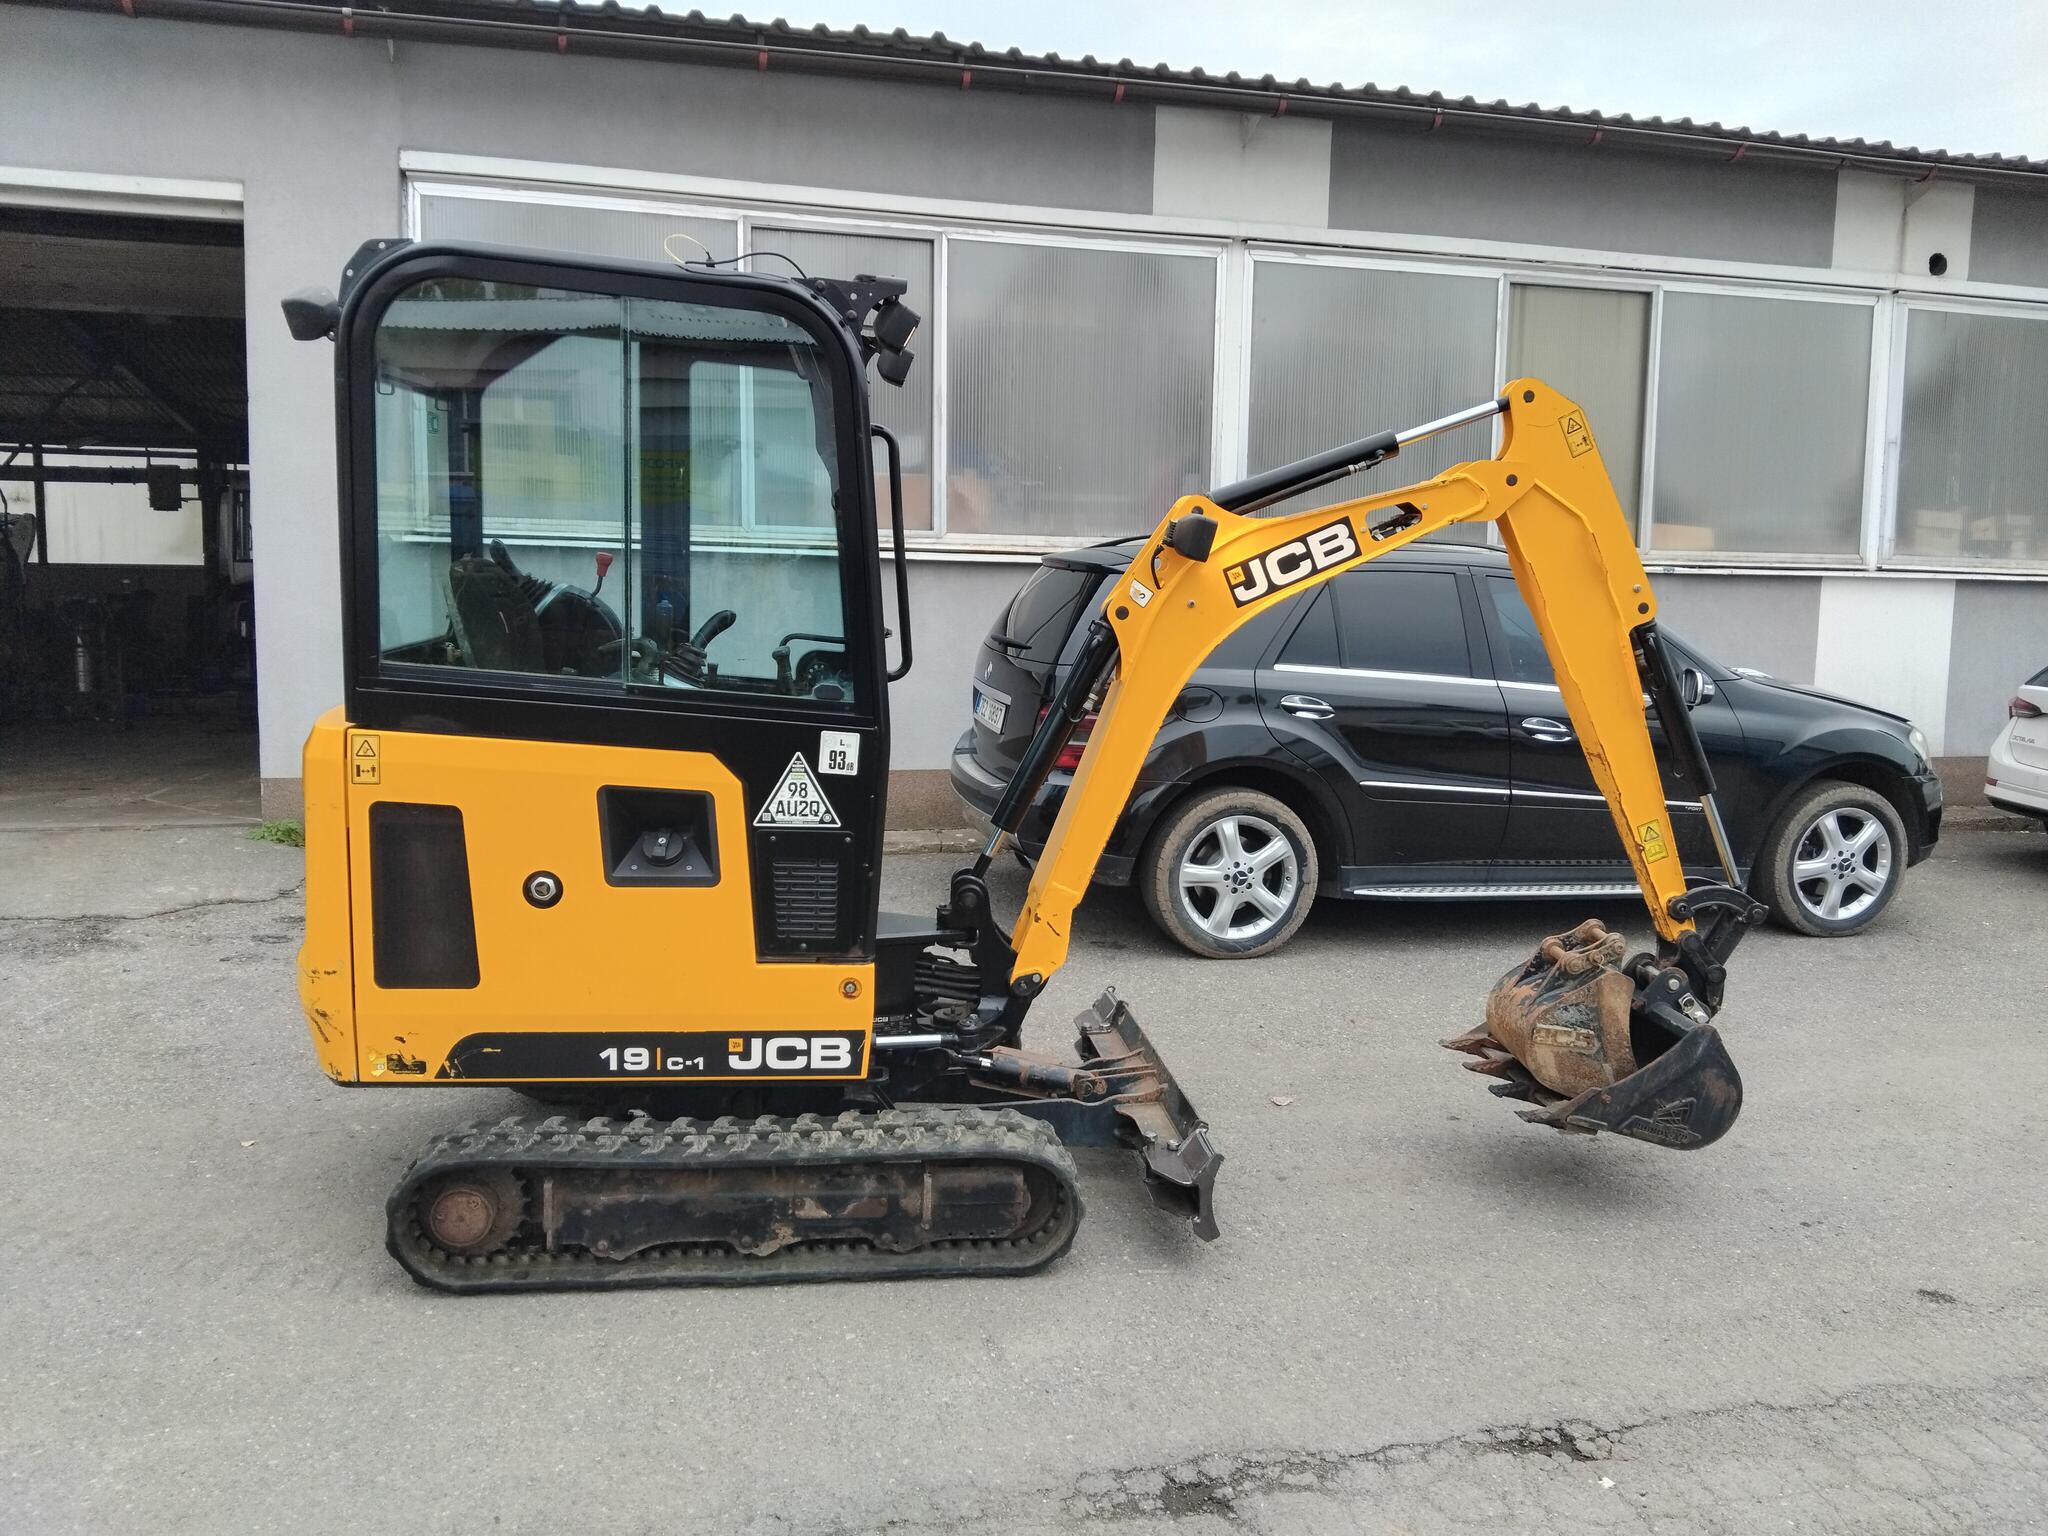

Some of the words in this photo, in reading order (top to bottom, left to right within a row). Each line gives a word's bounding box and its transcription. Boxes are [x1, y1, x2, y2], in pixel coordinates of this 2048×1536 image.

[1233, 523, 1356, 602] JCB
[829, 750, 847, 770] 93
[788, 782, 808, 799] 98
[776, 800, 820, 818] AU2Q
[599, 1047, 650, 1071] 19
[728, 1037, 851, 1070] JCB
